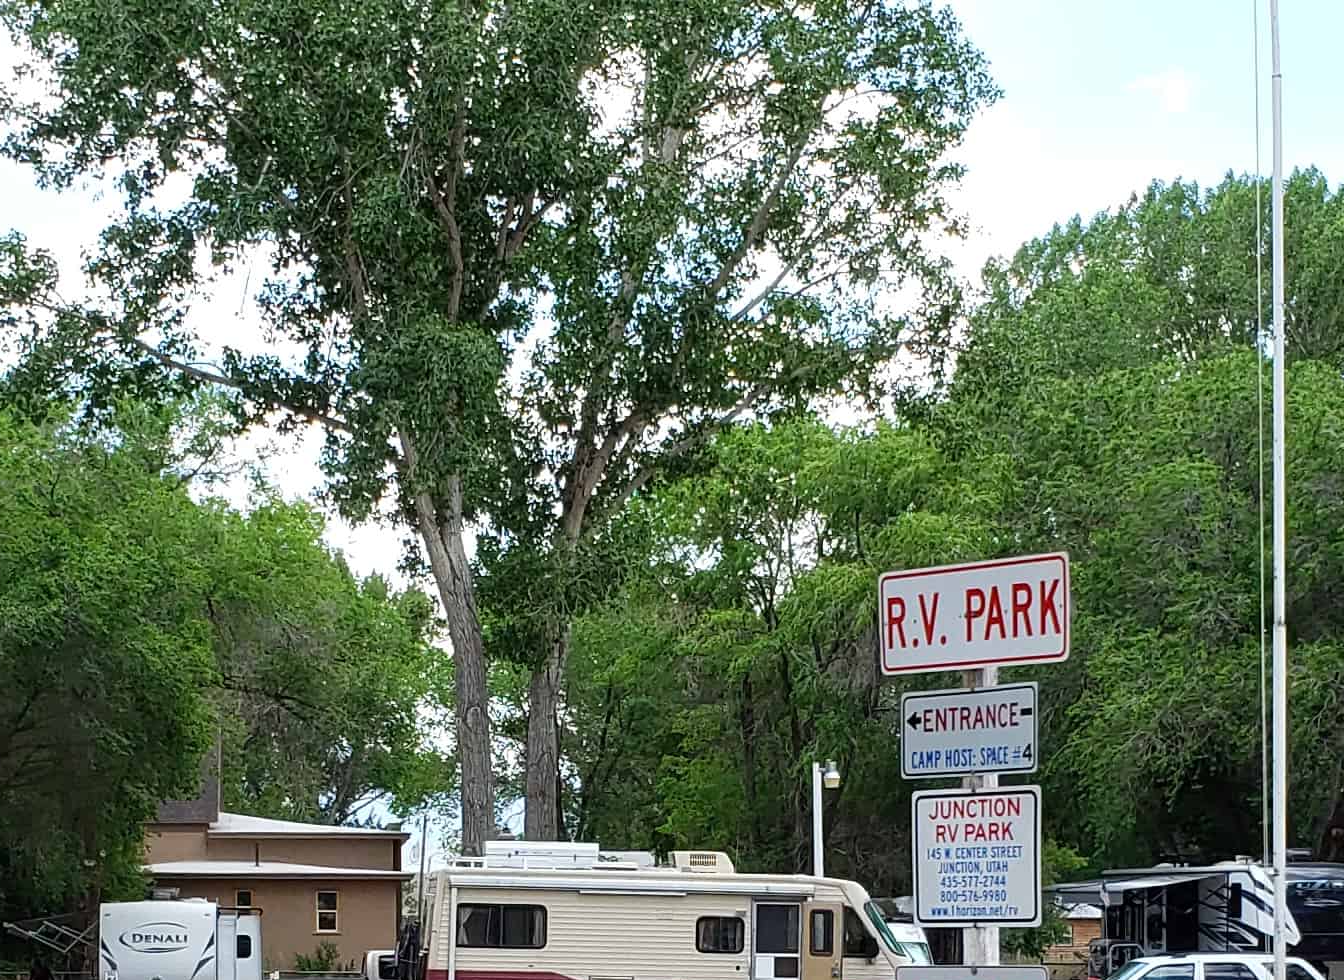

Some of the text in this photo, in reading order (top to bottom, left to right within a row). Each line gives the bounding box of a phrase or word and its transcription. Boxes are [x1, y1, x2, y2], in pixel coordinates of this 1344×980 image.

[887, 579, 1061, 649] R.V. PARK
[923, 702, 1019, 732] ENTRANCE
[911, 750, 941, 769] CAMP
[945, 749, 977, 767] HOST:
[980, 746, 1009, 765] SPACE
[929, 797, 1021, 820] JUNCTION
[935, 822, 1014, 843] RV PARK
[927, 848, 942, 860] 145
[955, 847, 988, 859] CENTER
[990, 845, 1023, 858] STREET
[938, 861, 1008, 875] JUNCTION, UTAH
[940, 876, 1007, 888] 435-577-2744
[940, 890, 1007, 903] 800-576-9980
[132, 933, 188, 943] DENALI
